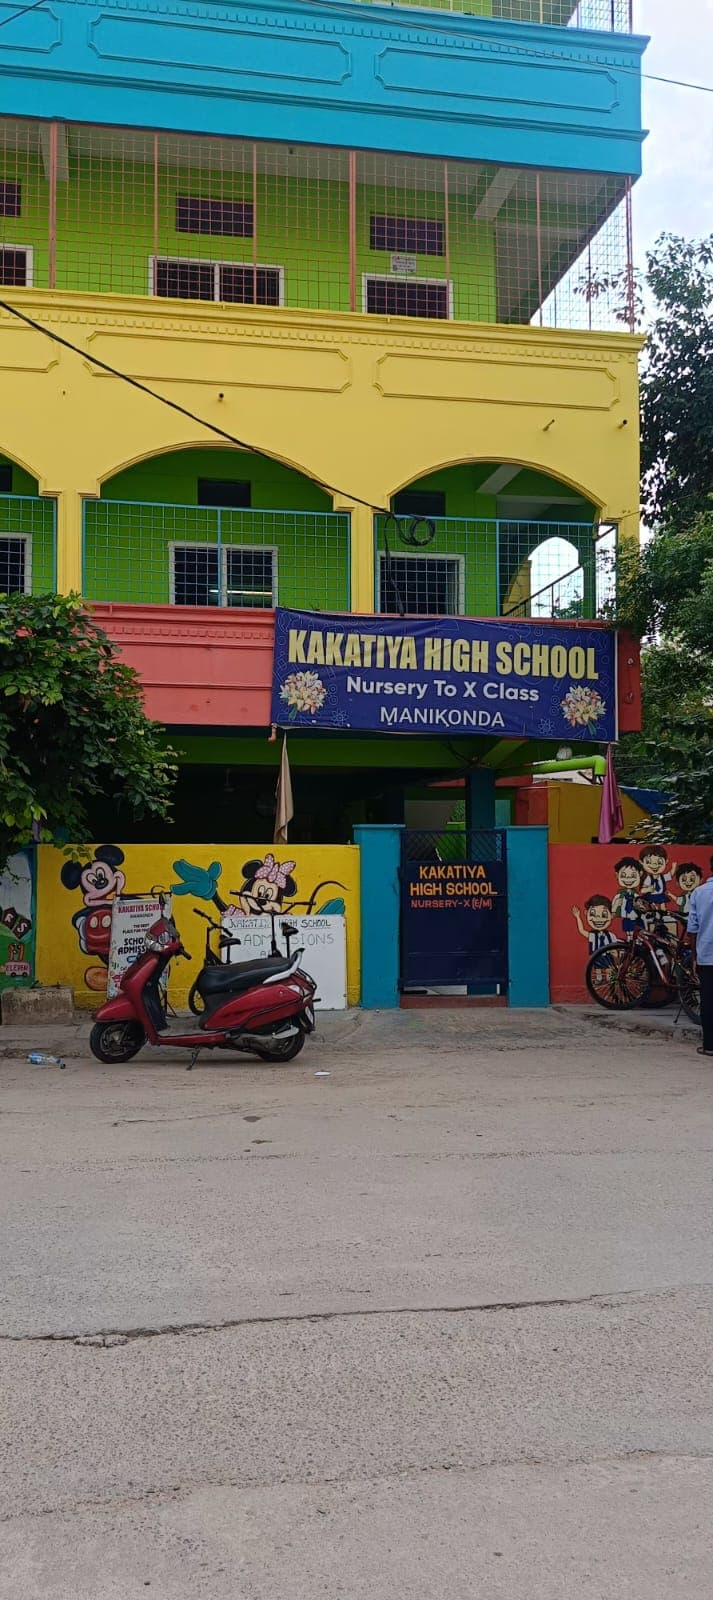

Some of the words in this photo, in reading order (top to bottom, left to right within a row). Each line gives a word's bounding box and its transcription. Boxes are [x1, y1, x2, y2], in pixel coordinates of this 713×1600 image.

[288, 629, 418, 670] KAKATIYA
[424, 637, 489, 674] HIGH
[496, 641, 599, 680] SCHOOL
[346, 676, 428, 699] Nursery
[433, 680, 457, 698] To
[463, 681, 476, 698] X
[483, 681, 540, 702] Class
[380, 706, 505, 728] MANIKONDA
[419, 865, 486, 879] KAKATIYA
[410, 882, 442, 896] HIGH
[446, 882, 498, 896] SCHOOL
[300, 919, 331, 928] SCHOOL
[123, 937, 144, 946] SCHO
[243, 933, 334, 946] ADMSIONS
